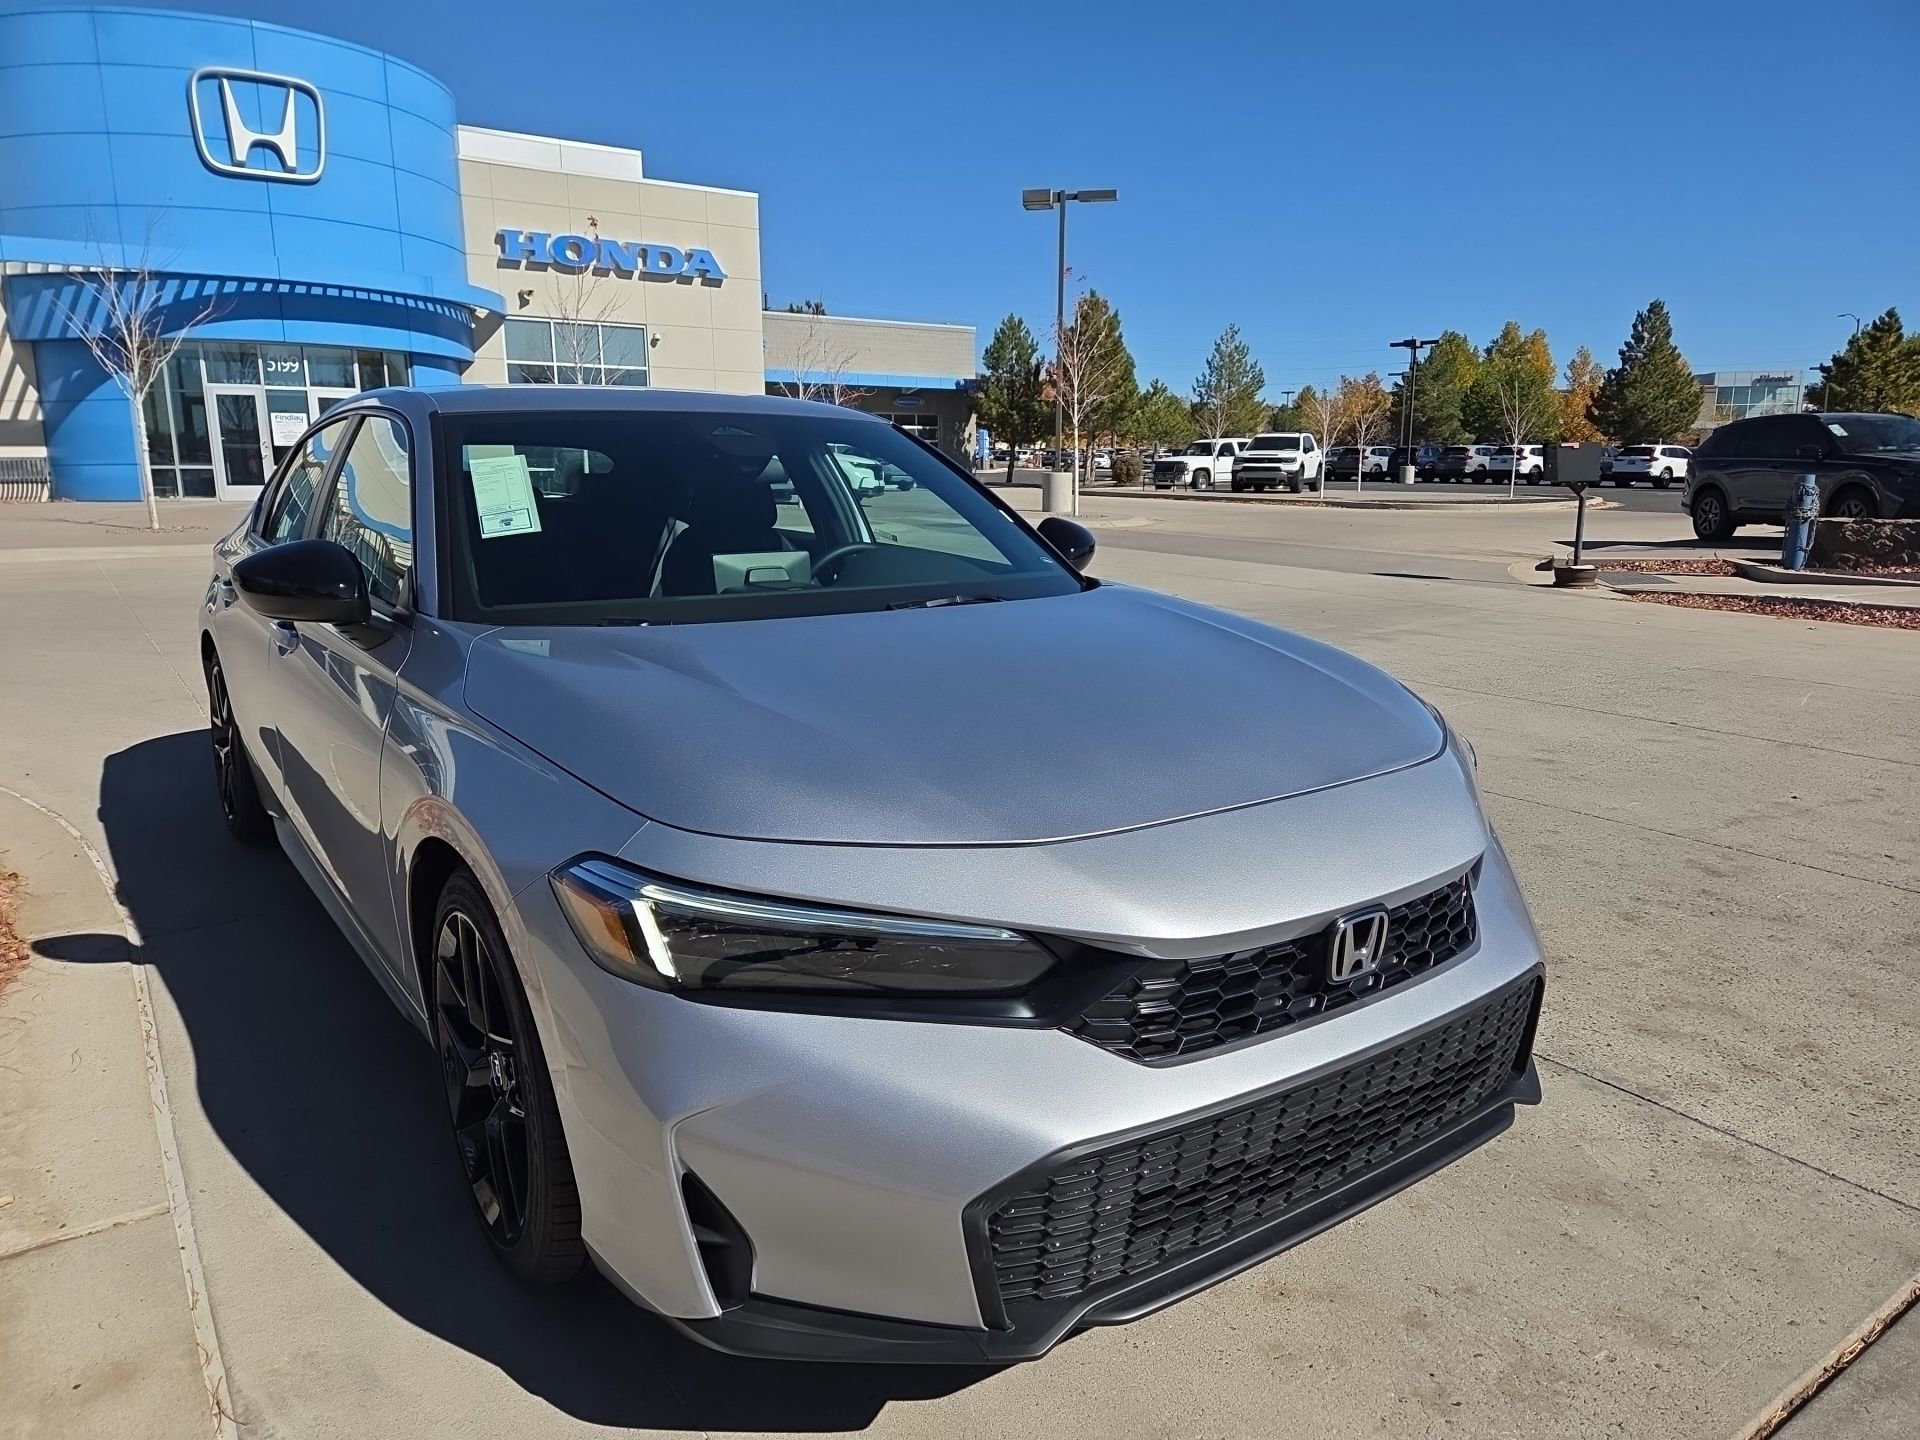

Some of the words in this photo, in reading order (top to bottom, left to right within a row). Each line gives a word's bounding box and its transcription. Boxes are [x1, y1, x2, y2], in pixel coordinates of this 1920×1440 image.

[495, 229, 728, 284] HONDA
[267, 354, 299, 373] 5199
[274, 414, 304, 423] Findlay
